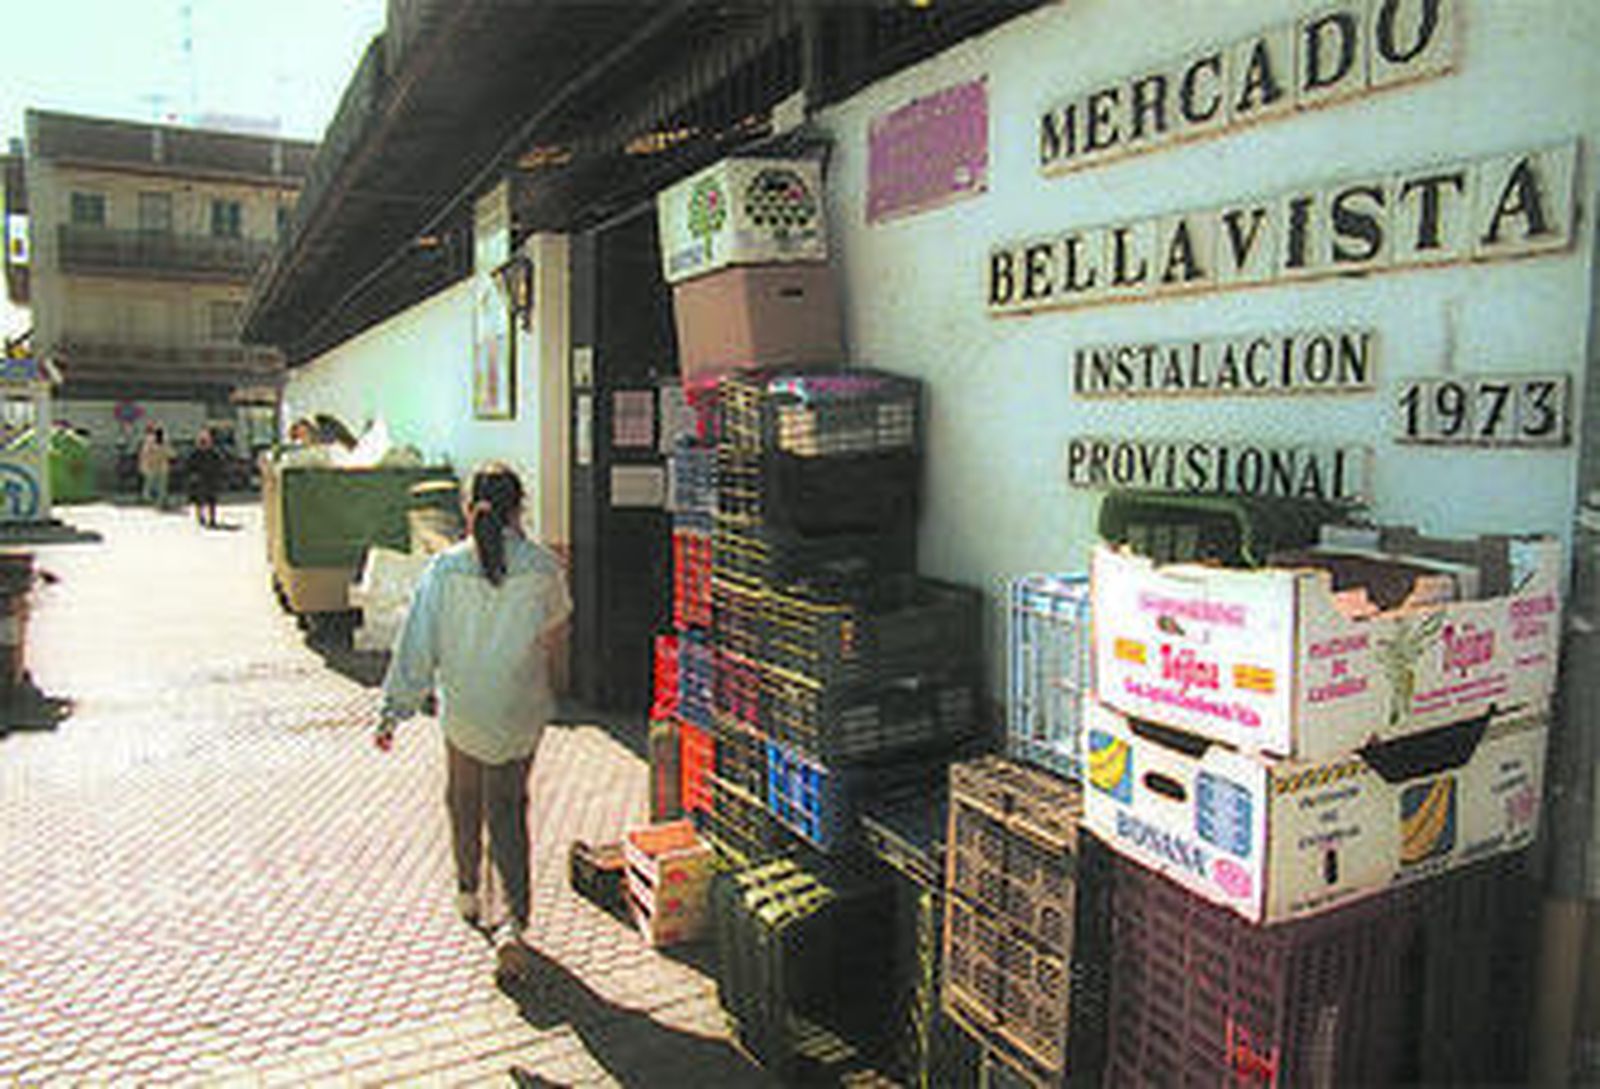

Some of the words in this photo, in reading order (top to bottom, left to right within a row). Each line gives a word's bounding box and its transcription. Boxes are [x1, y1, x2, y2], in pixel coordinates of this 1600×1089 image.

[1039, 0, 1438, 165] MERCADO
[988, 157, 1555, 305] BELLAVISTA
[1074, 334, 1371, 392] INSTALACION
[1400, 381, 1558, 436] 1973
[1068, 441, 1349, 499] PROVISIONAL
